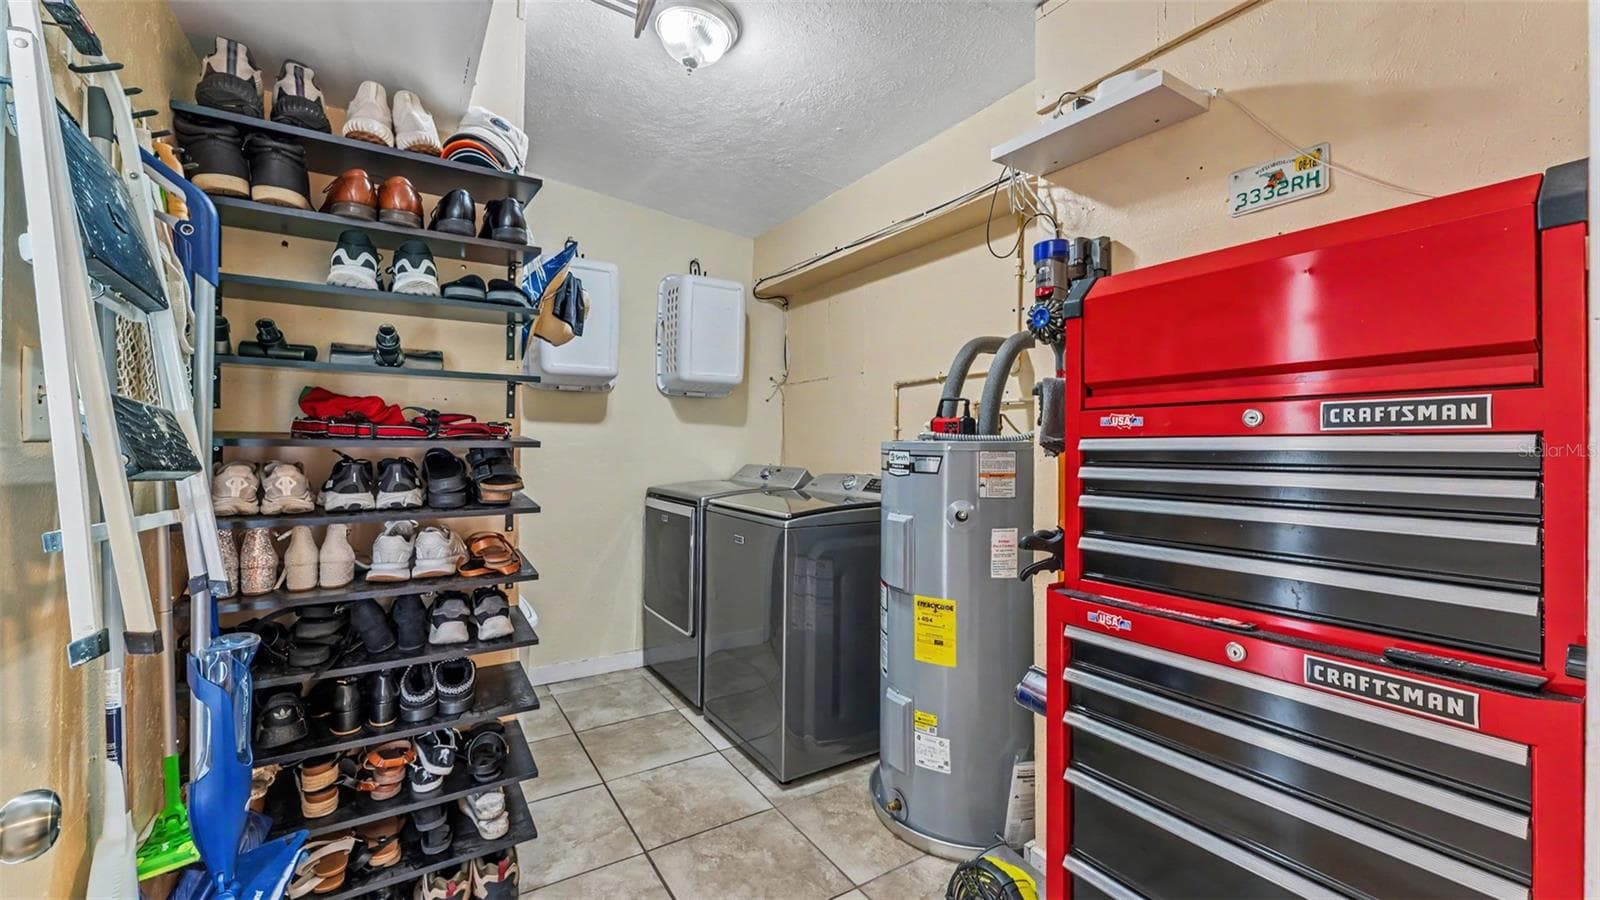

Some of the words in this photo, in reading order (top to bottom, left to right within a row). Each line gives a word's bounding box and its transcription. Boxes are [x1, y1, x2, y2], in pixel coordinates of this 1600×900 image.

[1236, 170, 1321, 209] 3332RH
[1111, 416, 1131, 426] USA
[1329, 402, 1478, 423] CRAFTSMAN
[1099, 613, 1119, 627] USA
[1313, 663, 1465, 717] CRAFTSMAN
